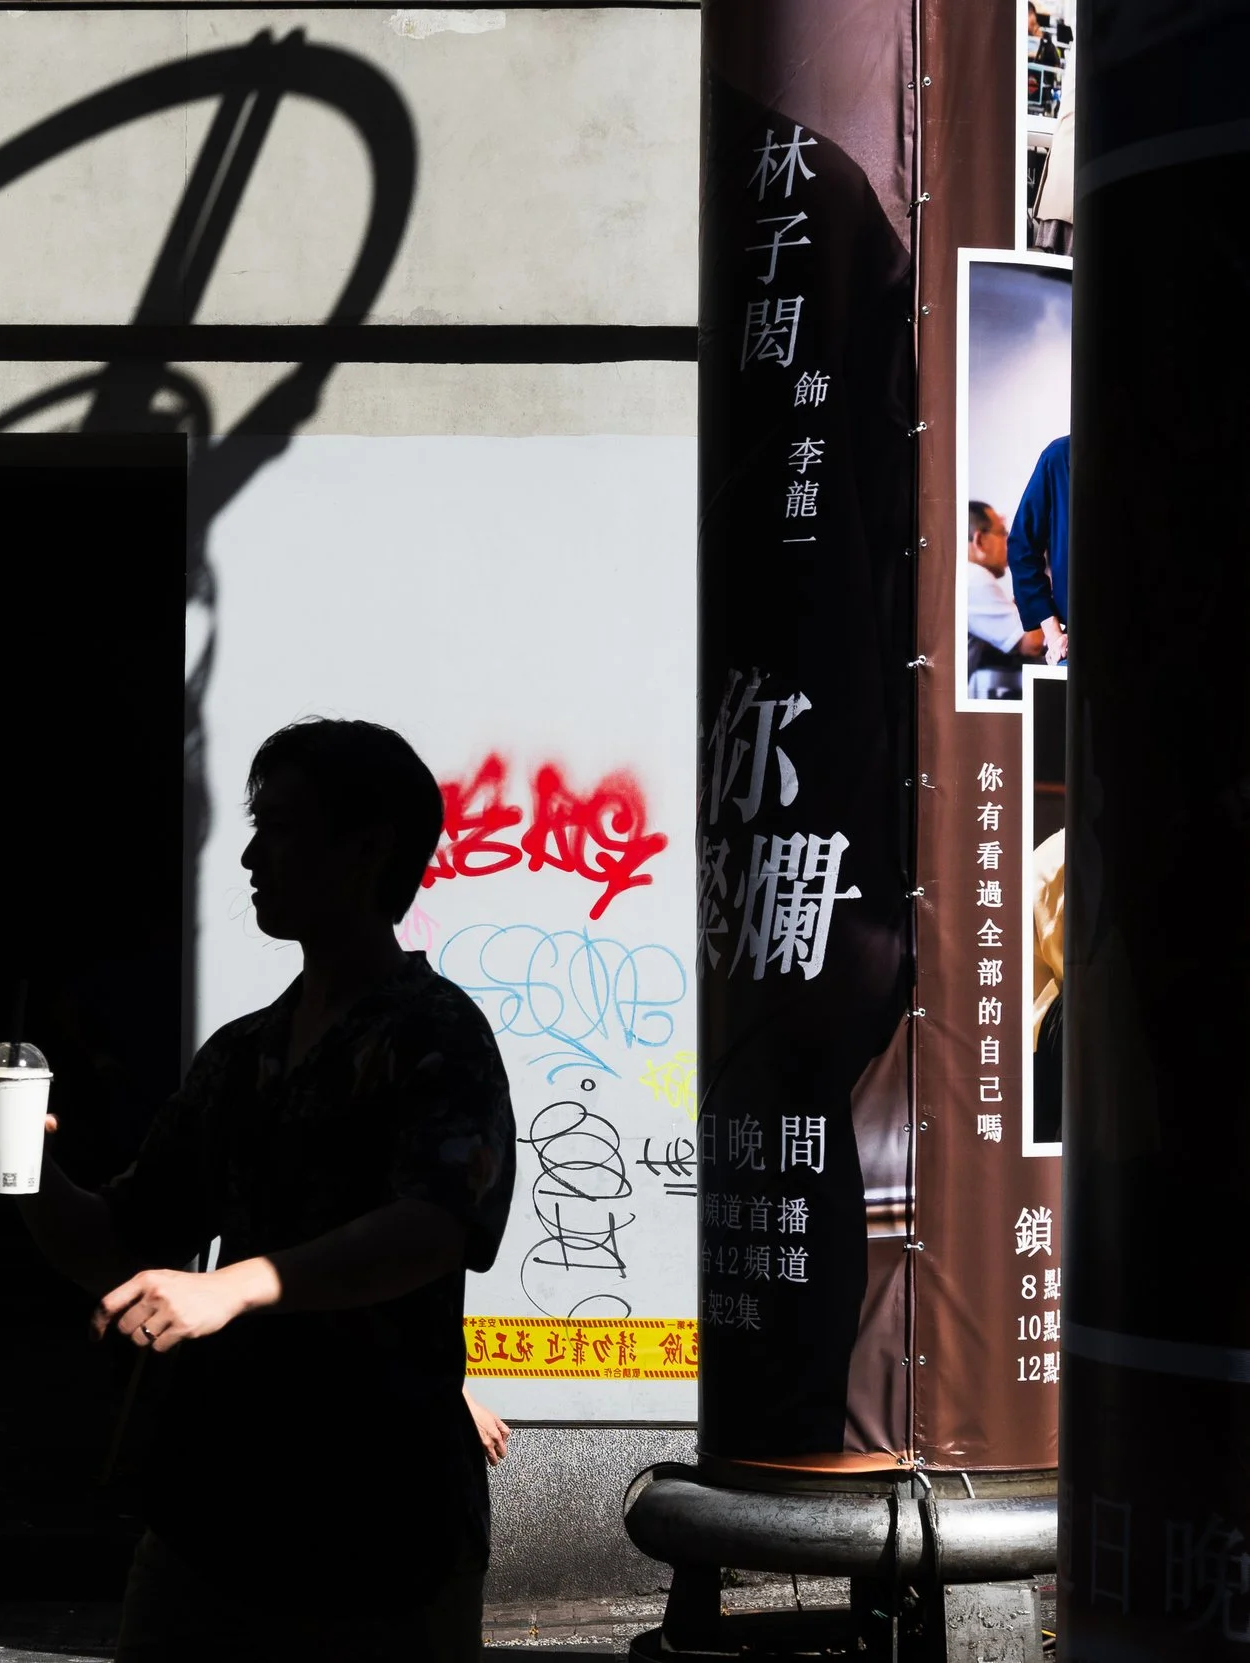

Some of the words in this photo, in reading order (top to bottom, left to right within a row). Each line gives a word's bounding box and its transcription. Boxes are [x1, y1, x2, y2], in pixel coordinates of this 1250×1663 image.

[740, 124, 819, 372] 林子閎
[793, 369, 831, 408] 飾
[782, 436, 826, 545] 李龍一
[698, 666, 813, 826] 你
[976, 761, 1003, 1144] 你有看過全部的自己嗎
[1014, 1205, 1053, 1258] 鎖
[1017, 1308, 1061, 1342] 10點
[1017, 1350, 1060, 1384] 12點
